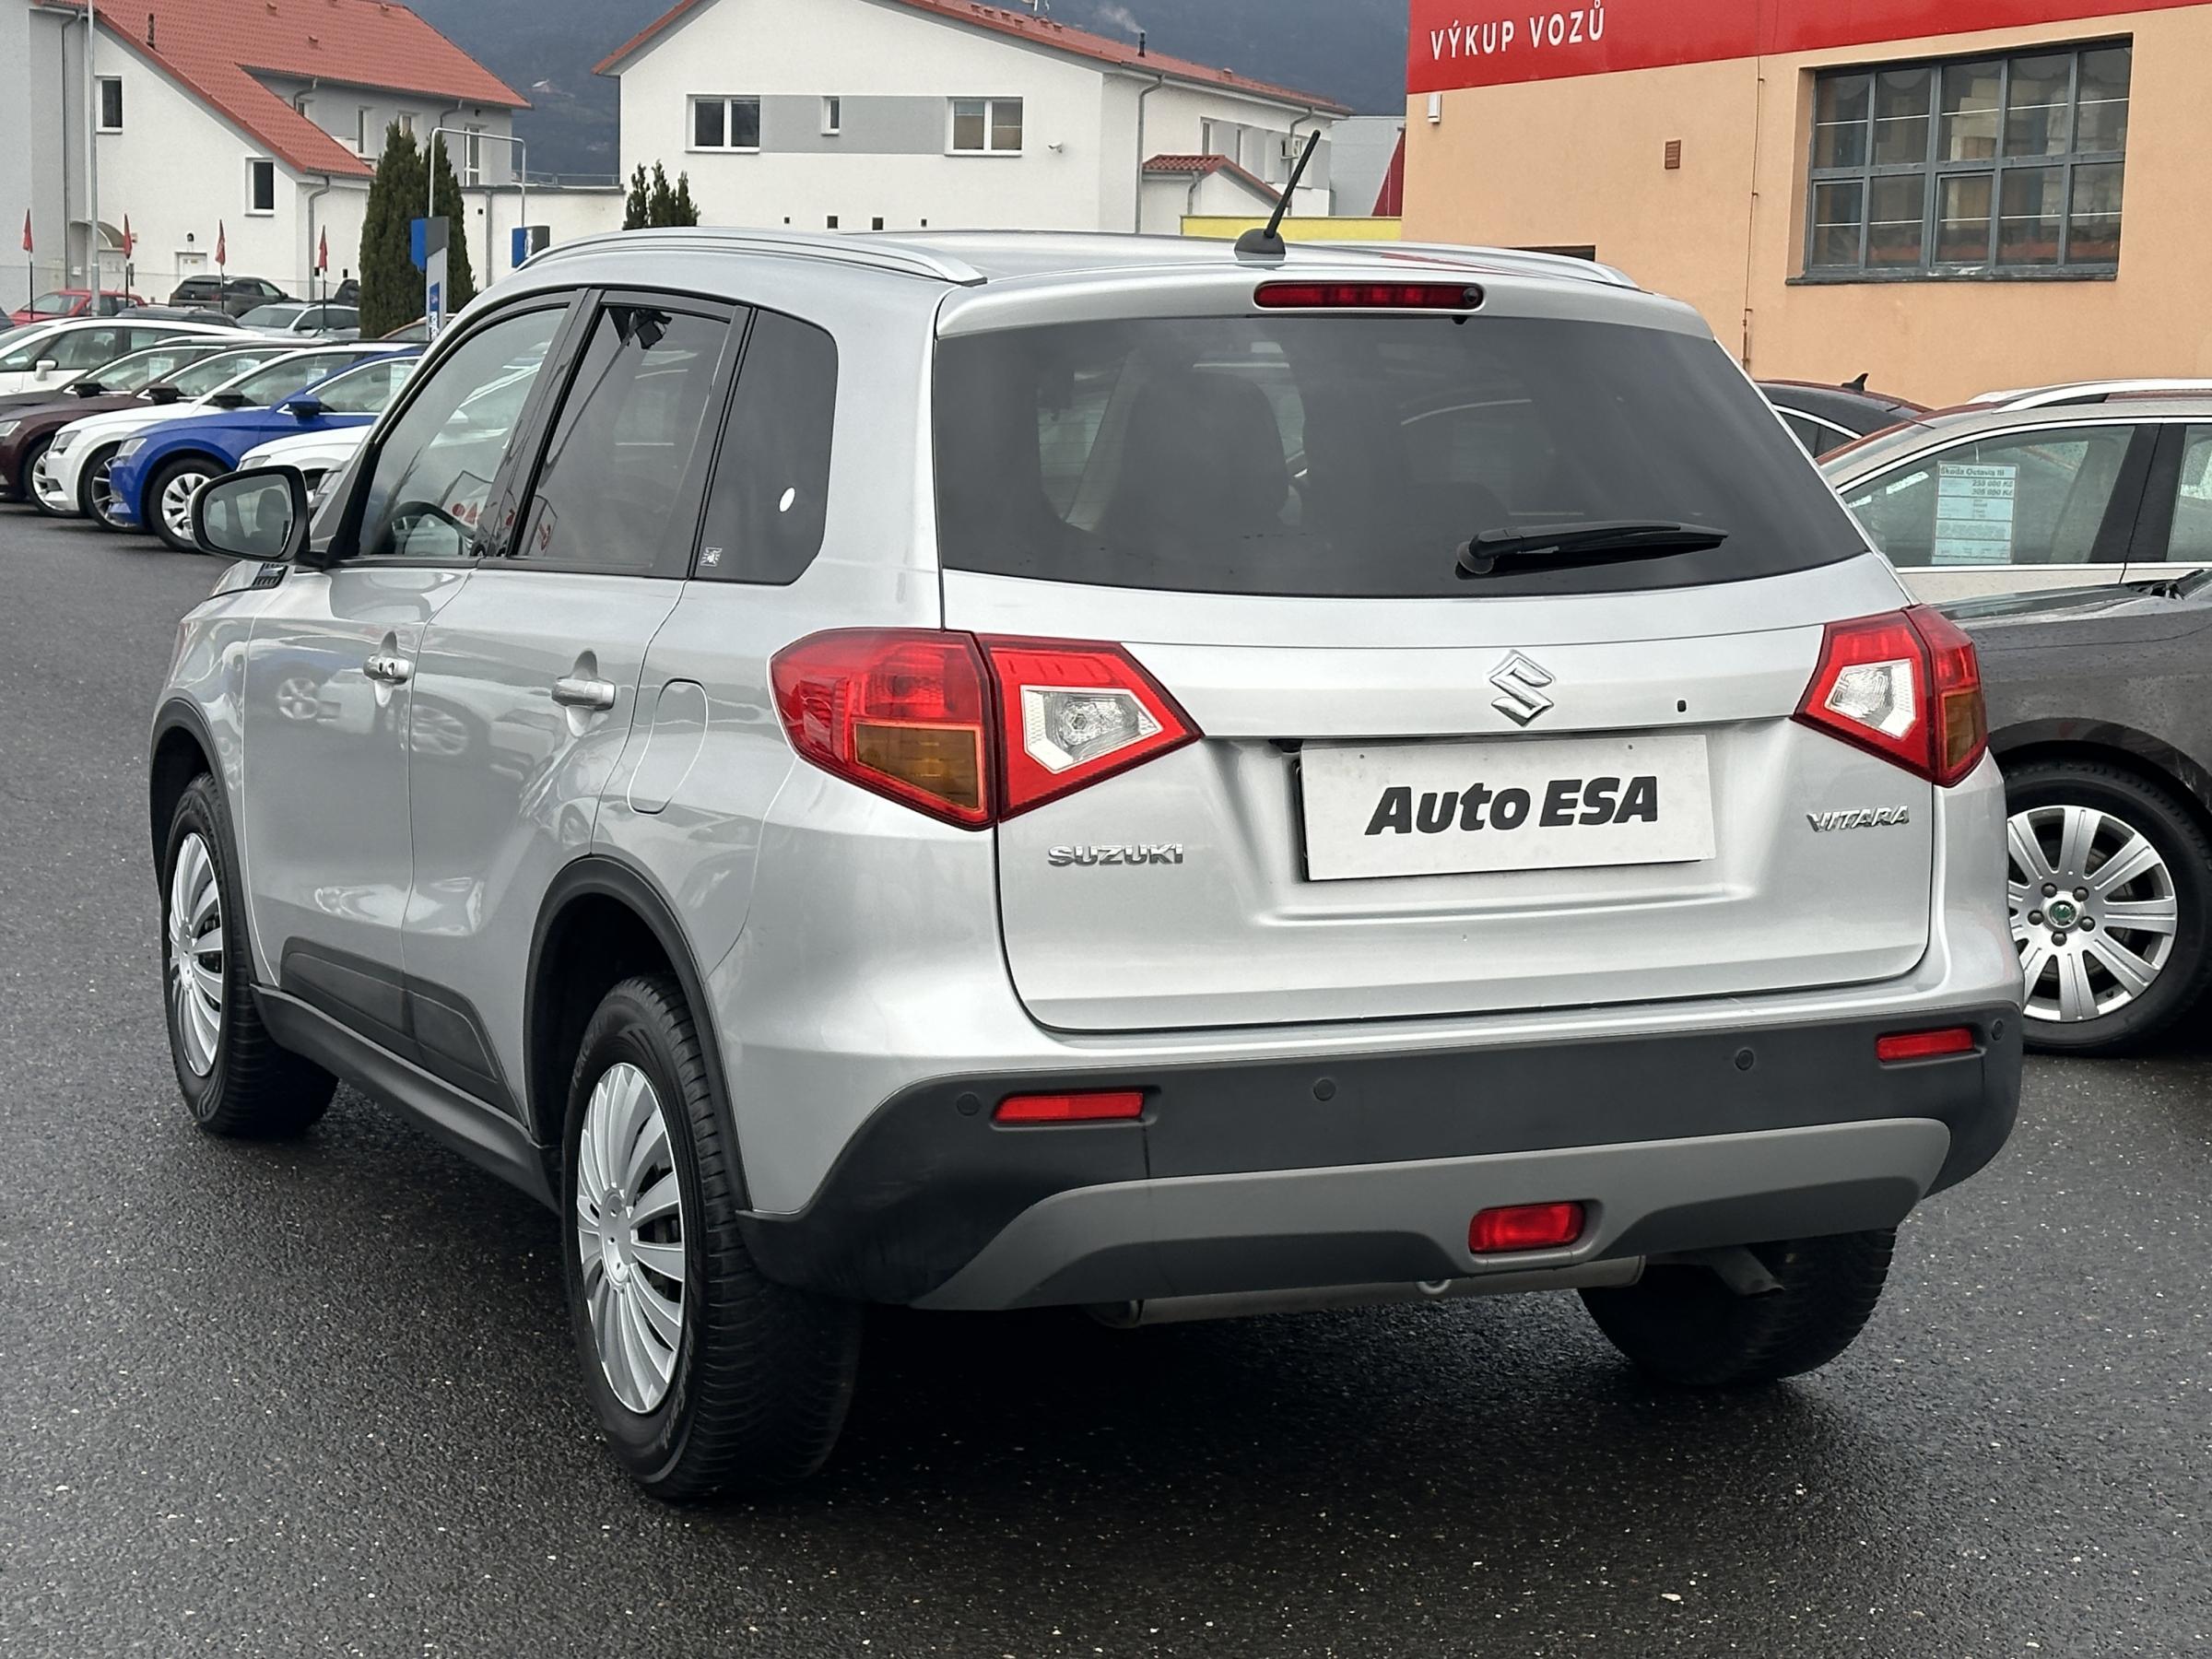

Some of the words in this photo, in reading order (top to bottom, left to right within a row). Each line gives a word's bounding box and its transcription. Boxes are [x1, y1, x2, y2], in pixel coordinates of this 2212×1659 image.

[1430, 18, 1514, 61] VÝKUP
[1529, 0, 1605, 49] VOZŮ
[1364, 782, 1531, 836] Auto
[1538, 775, 1658, 828] ESA
[1806, 805, 1910, 832] VITARA
[1047, 842, 1184, 867] SUZUKI
